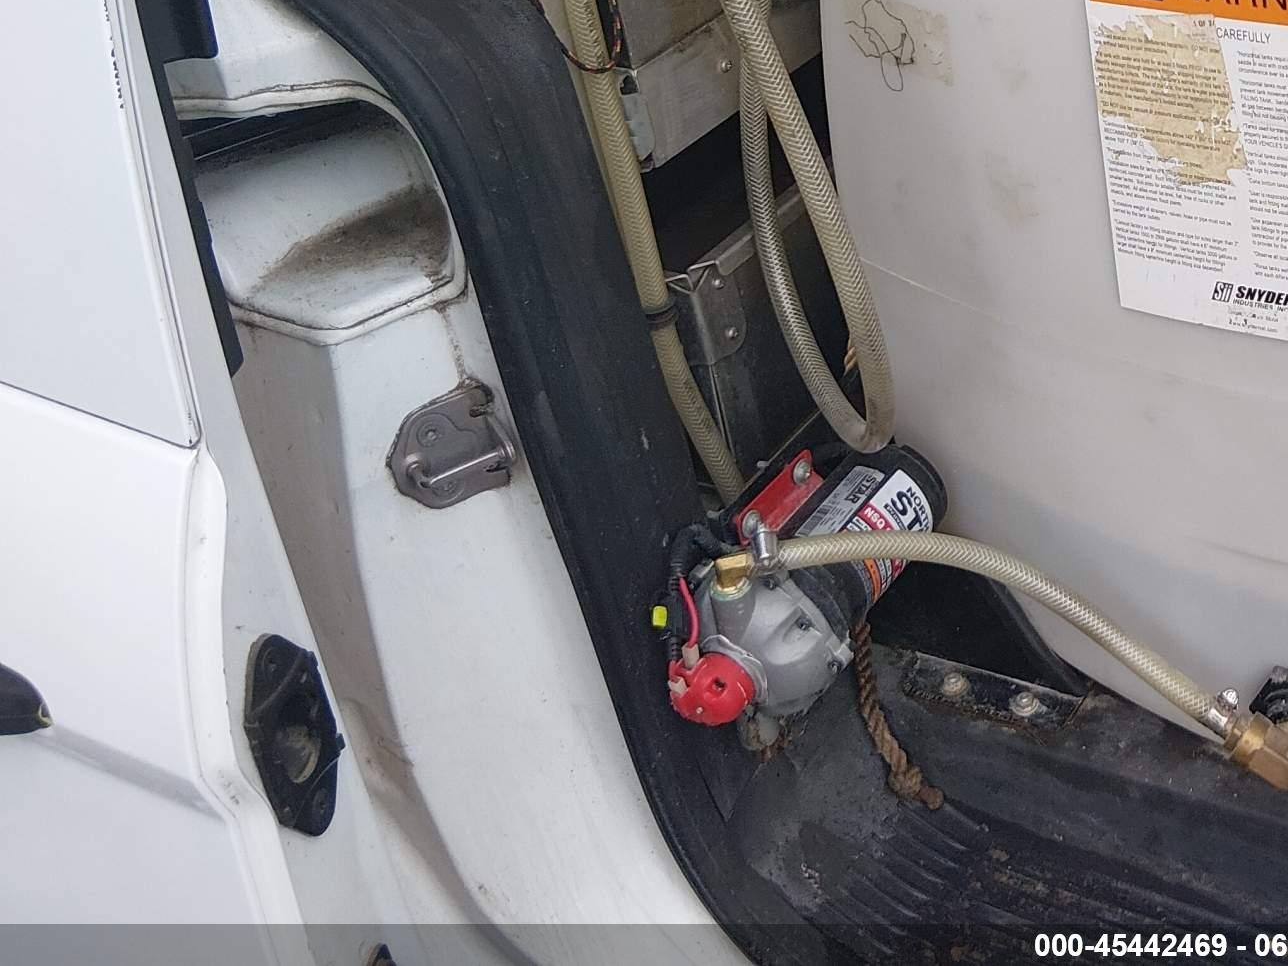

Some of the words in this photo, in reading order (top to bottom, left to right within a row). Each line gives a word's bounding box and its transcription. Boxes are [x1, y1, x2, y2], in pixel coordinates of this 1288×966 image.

[1216, 27, 1270, 44] CAREFULLY
[845, 474, 876, 504] STAR
[864, 506, 886, 529] NSQ
[890, 490, 924, 533] ST
